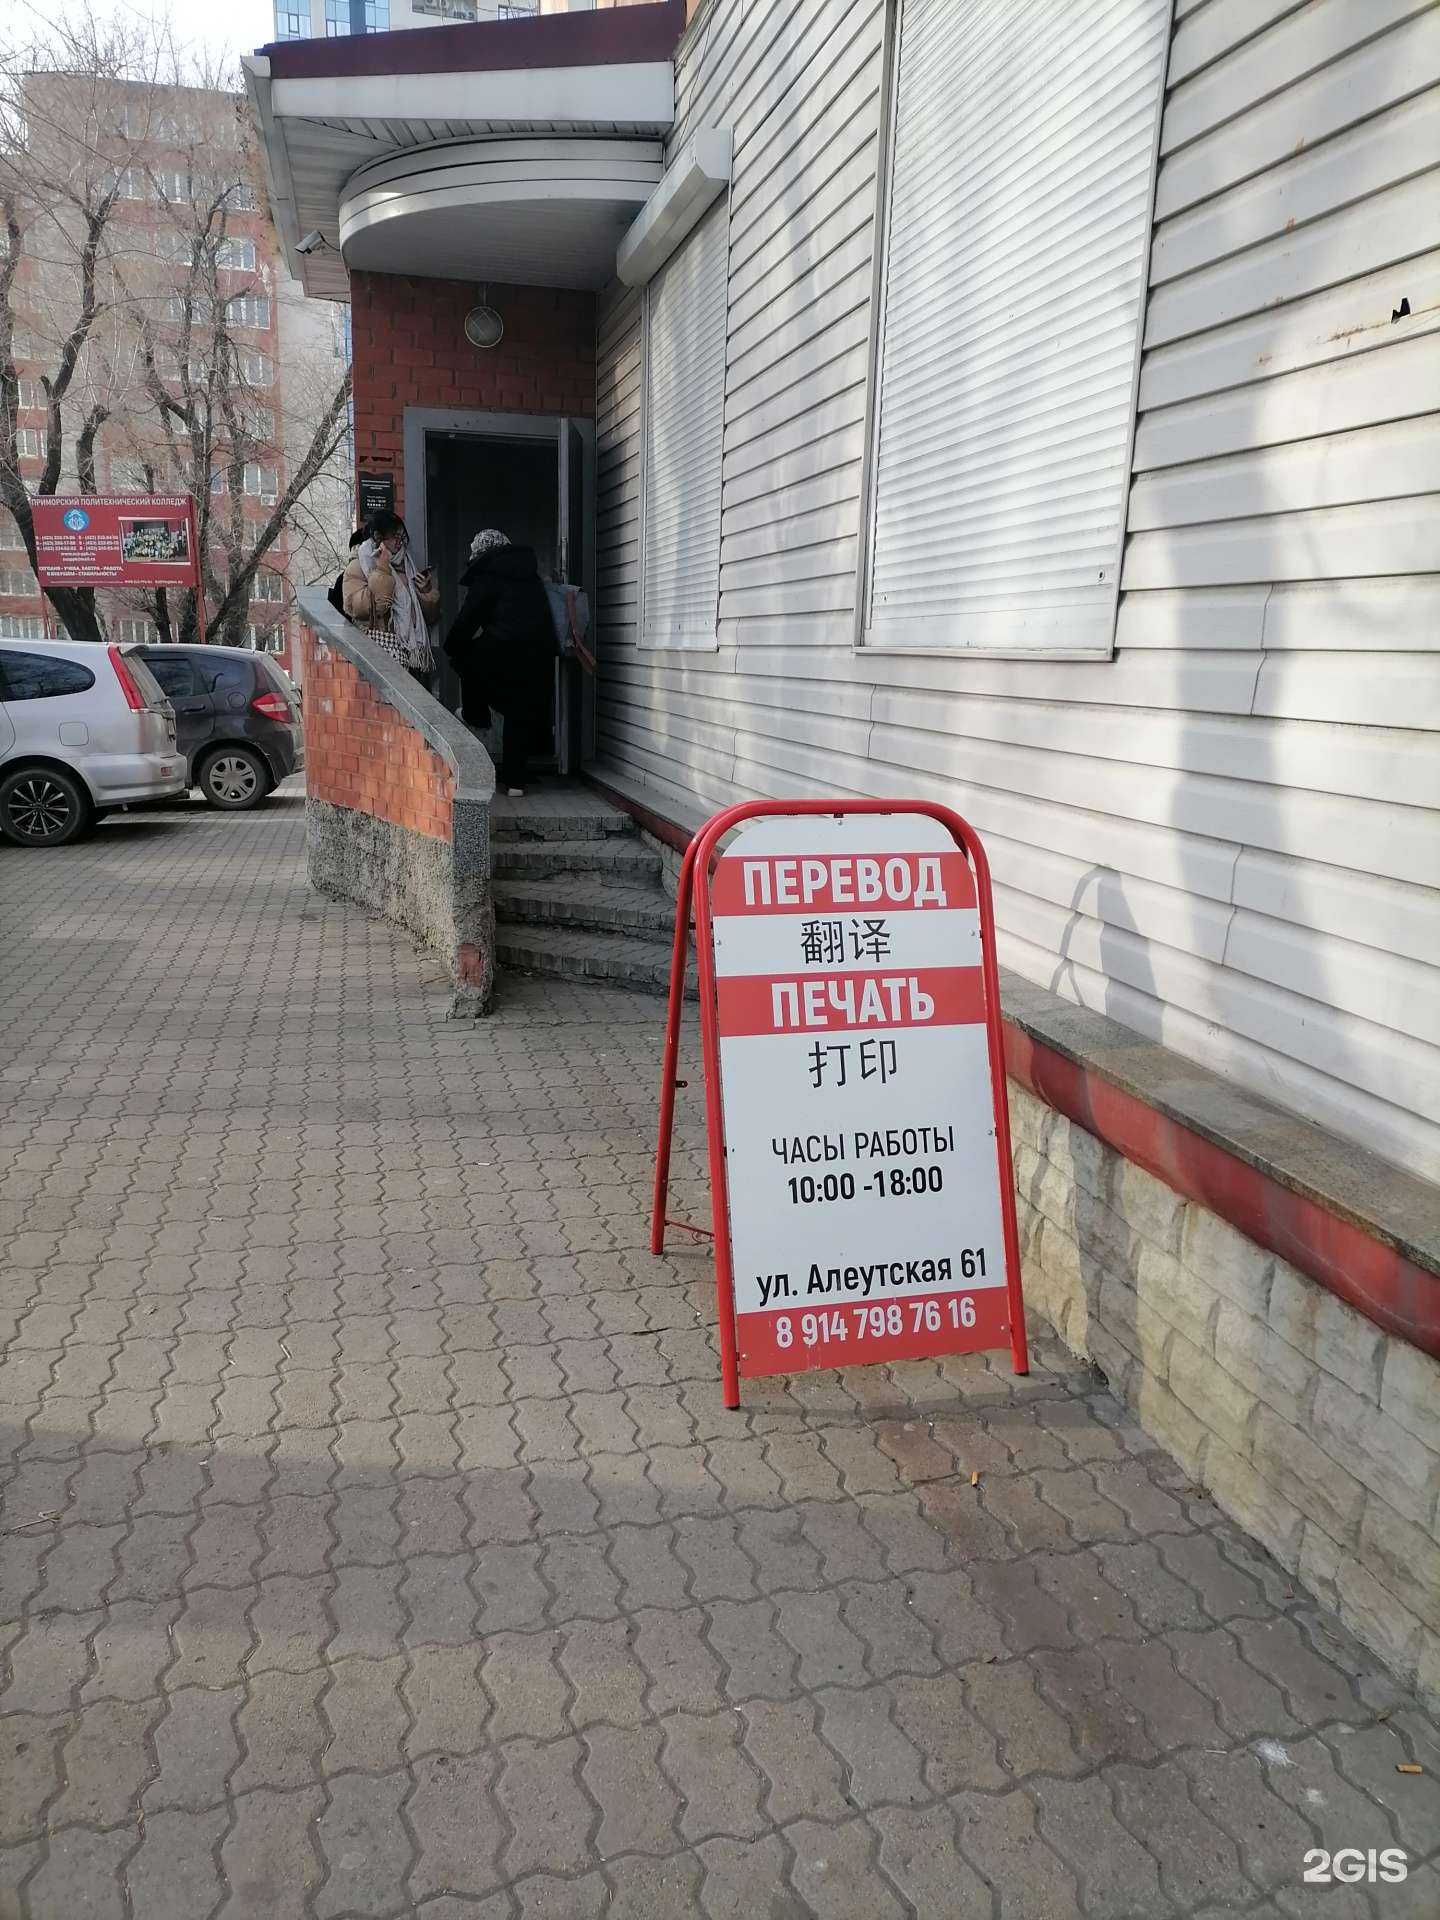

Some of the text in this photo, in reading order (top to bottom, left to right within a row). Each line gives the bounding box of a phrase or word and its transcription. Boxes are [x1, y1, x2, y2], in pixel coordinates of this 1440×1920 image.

[31, 497, 187, 506] ПРИМОРСКИЙ ПОЛИТЕХНИЧЕСКИЙ КОЛЛЕДЖ
[743, 857, 947, 907] ПЕРЕВОД
[800, 918, 891, 964] 翻译
[771, 977, 935, 1028] ПЕЧАТЬ
[808, 1038, 897, 1088] 打印
[772, 1126, 955, 1165] ЧАСЫ РАБОТЫ
[788, 1172, 855, 1204] 10:00
[756, 1247, 987, 1307] ул. Алеутская 61
[775, 1296, 977, 1348] 8 914 798 76 16
